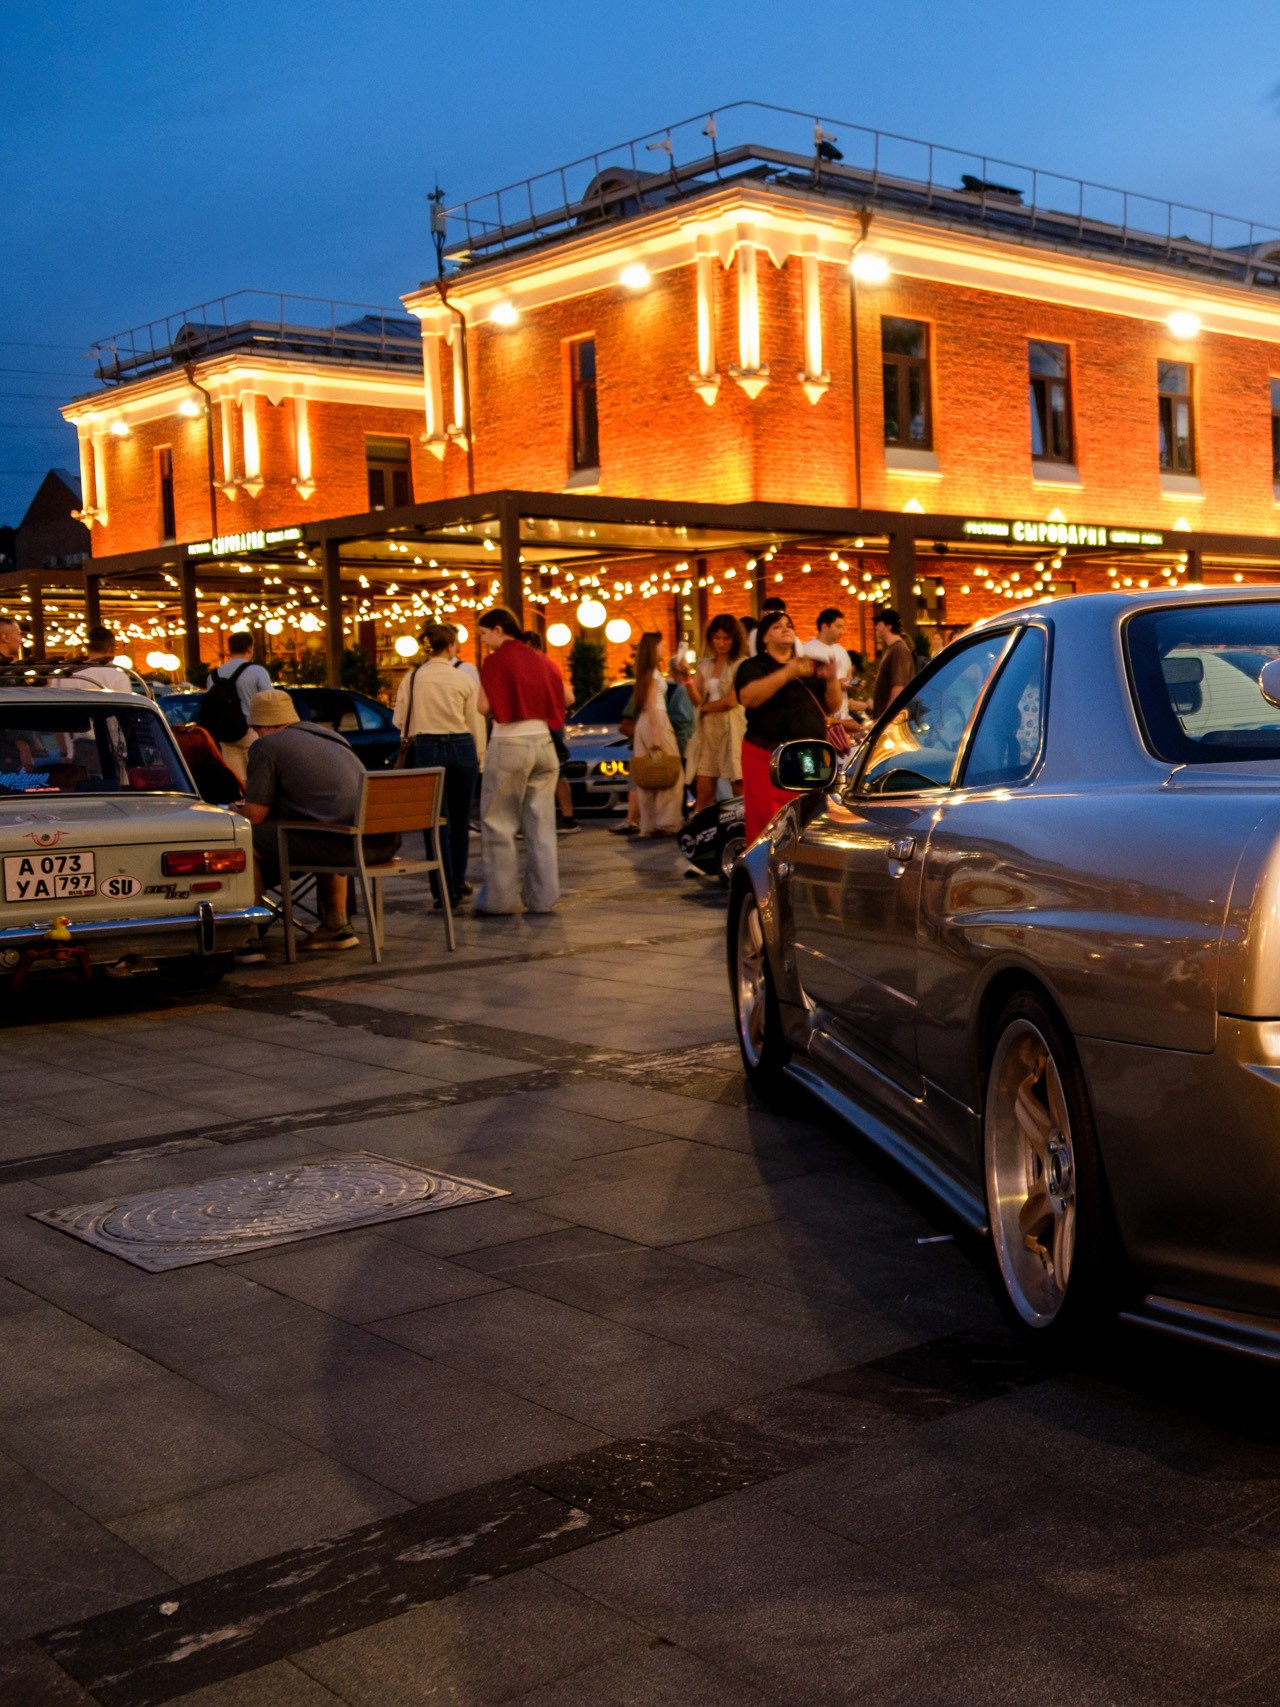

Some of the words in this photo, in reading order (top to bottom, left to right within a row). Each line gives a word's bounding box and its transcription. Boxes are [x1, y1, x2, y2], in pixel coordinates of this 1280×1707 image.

[1013, 521, 1107, 546] СЫРОВАРНЯ
[40, 855, 82, 874] 073
[58, 875, 92, 891] 797
[108, 879, 133, 896] SU
[145, 885, 176, 894] FIAT
